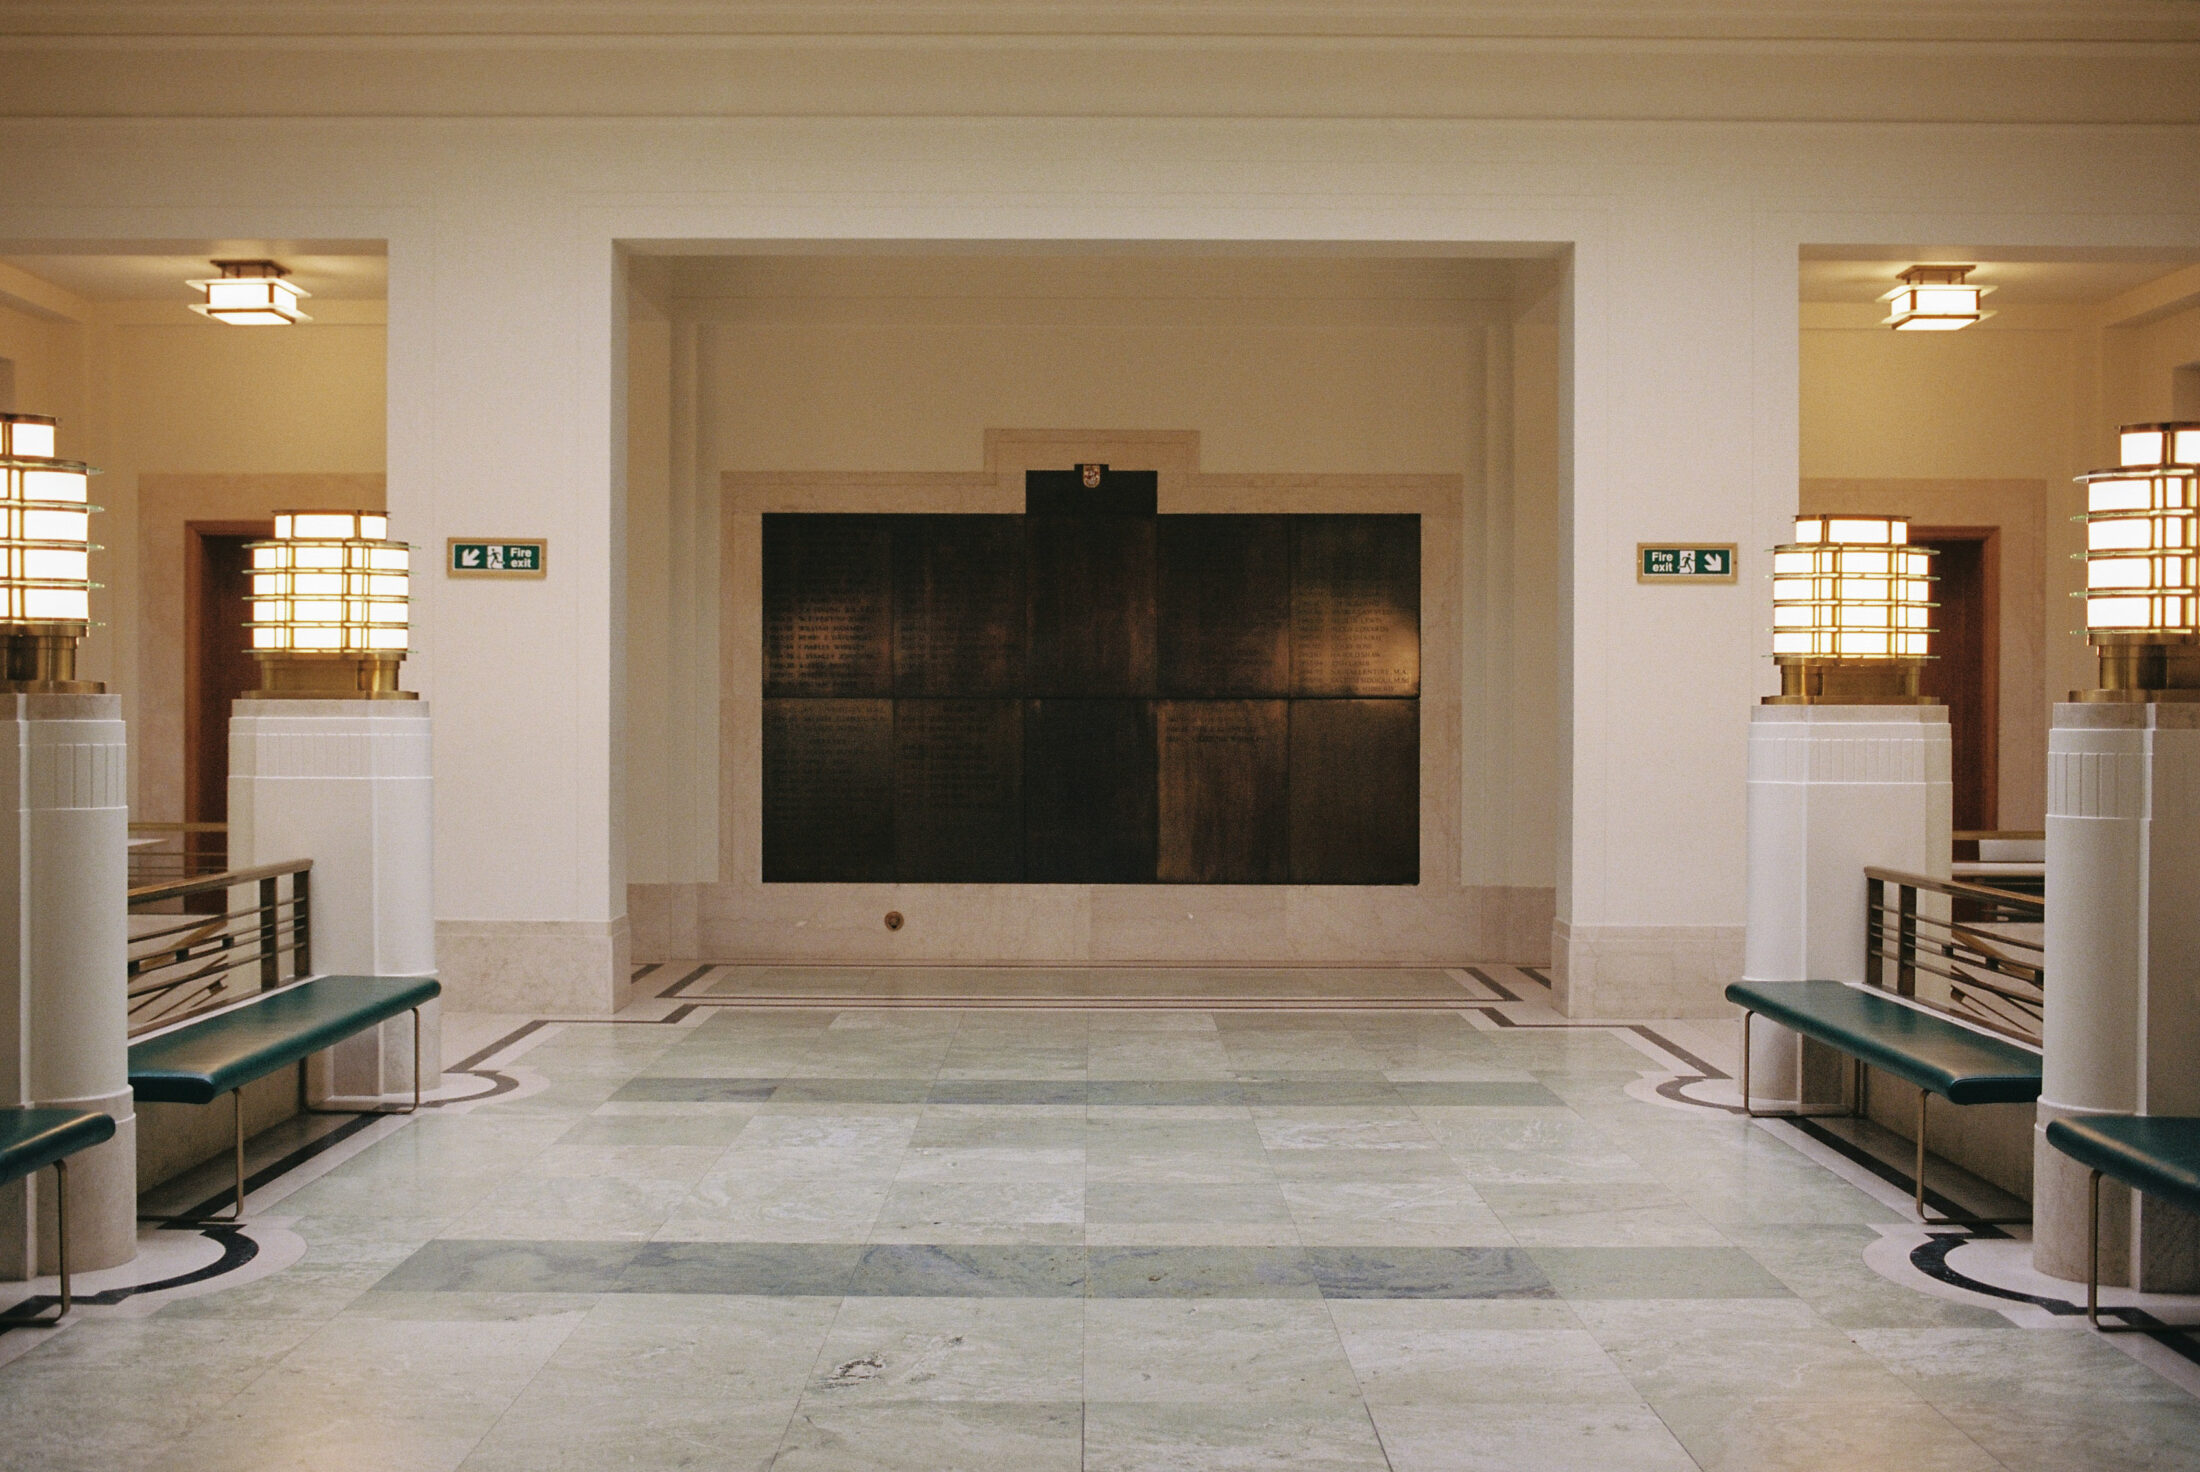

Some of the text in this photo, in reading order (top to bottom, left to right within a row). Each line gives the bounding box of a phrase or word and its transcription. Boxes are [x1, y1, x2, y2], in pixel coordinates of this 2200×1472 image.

[510, 547, 532, 558] Fire
[1651, 551, 1674, 562] Fire
[510, 558, 532, 568] exit
[1652, 562, 1673, 572] exit
